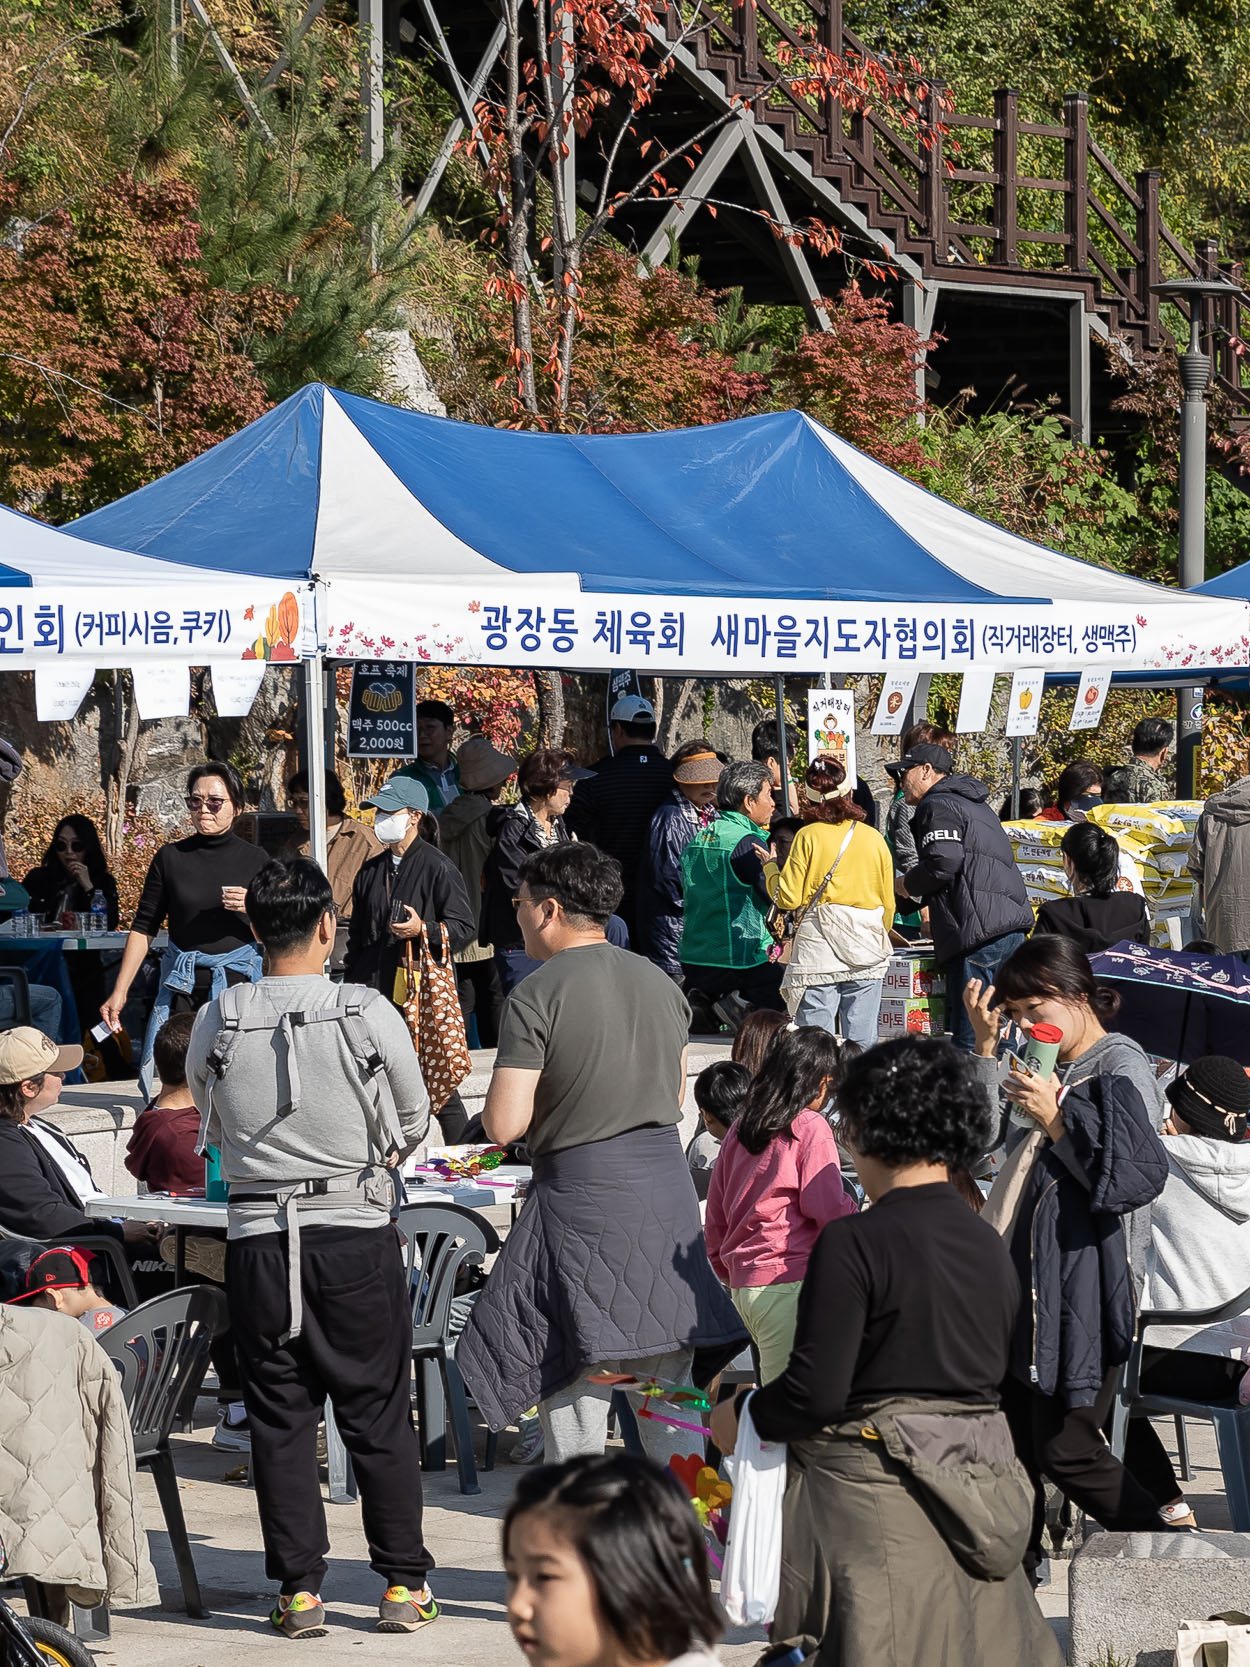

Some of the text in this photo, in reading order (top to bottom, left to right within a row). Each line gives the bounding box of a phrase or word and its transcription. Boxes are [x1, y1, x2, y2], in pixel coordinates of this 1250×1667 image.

[75, 608, 231, 647] (커피시음,쿠키)
[481, 605, 1137, 660] 광장동 체육회 새마을지도자협의회 (직거래장터, 생맥주)
[352, 718, 413, 732] 맥주 500cc
[359, 736, 405, 750] 2,000원
